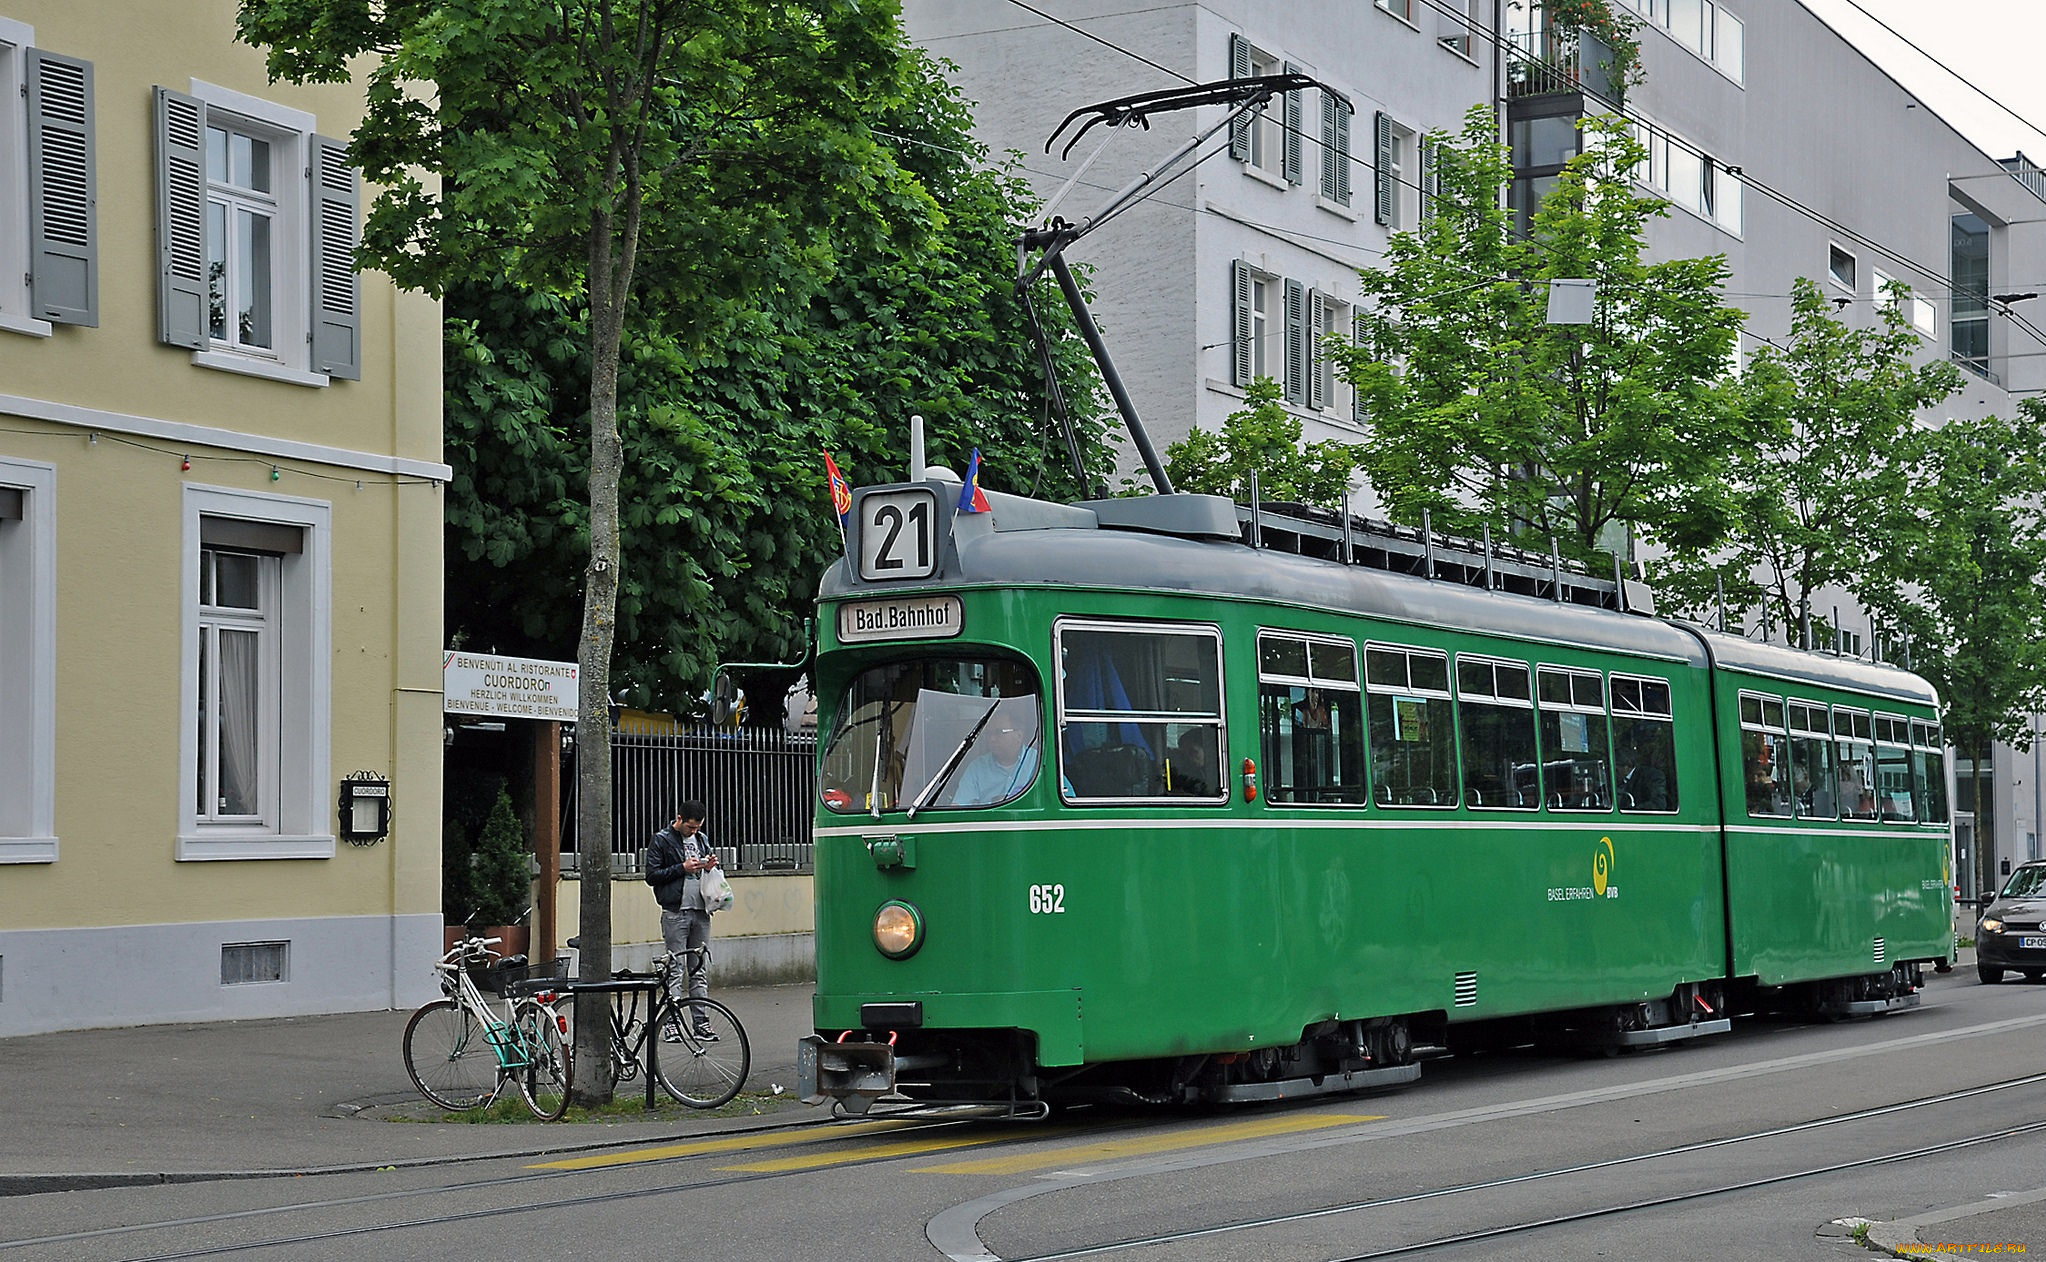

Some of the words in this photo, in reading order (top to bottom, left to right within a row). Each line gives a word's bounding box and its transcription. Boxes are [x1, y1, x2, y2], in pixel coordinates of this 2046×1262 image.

[874, 502, 929, 570] 21
[457, 657, 504, 671] BENVENUTI
[507, 662, 518, 674] AL
[521, 663, 570, 678] RISTORANTE
[484, 674, 545, 691] CUORDORO
[471, 689, 507, 700] HERZLICH
[510, 692, 558, 704] WILLKOMMEN
[447, 699, 489, 711] BIENVENUE
[496, 703, 532, 713] WELCOME
[1029, 884, 1065, 914] 652
[1547, 888, 1565, 901] BASEL
